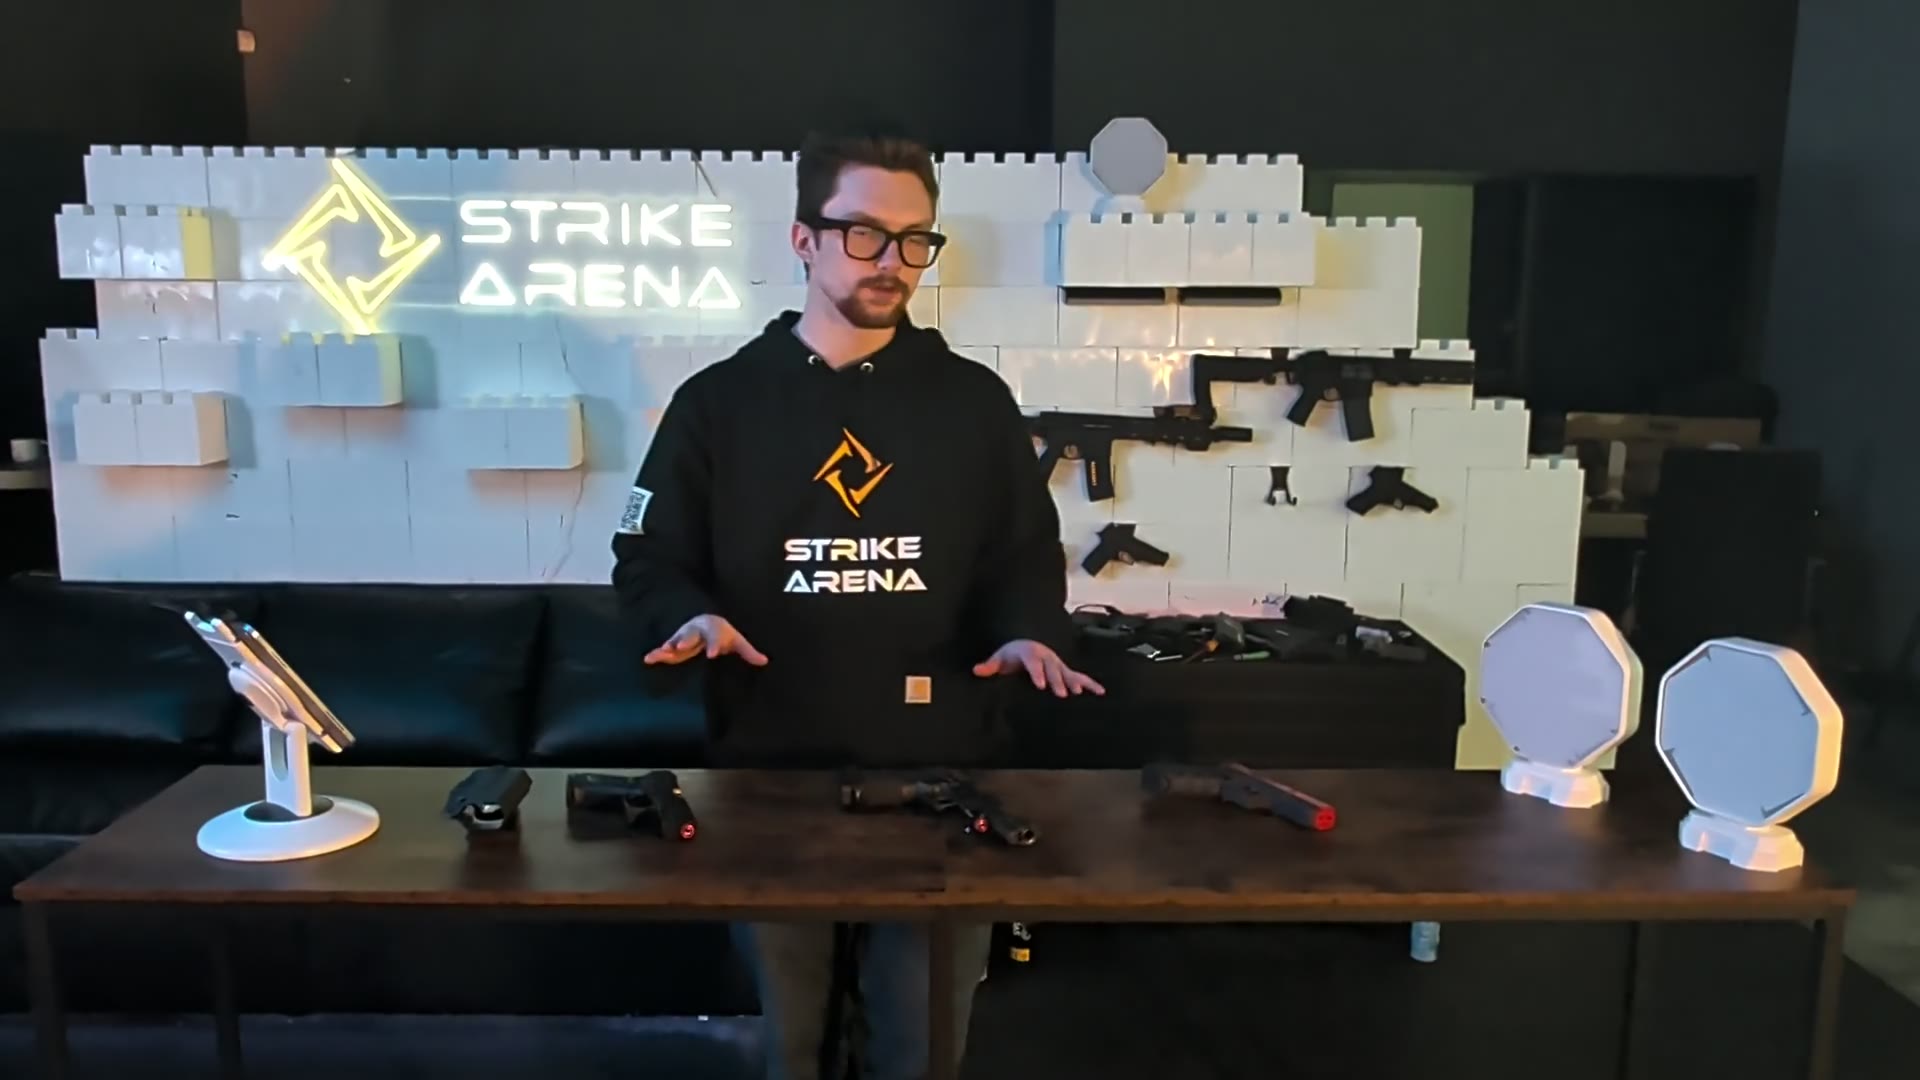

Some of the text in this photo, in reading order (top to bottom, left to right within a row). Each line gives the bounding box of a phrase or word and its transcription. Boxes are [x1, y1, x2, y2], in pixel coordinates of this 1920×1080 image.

[459, 199, 733, 247] STRIKE
[459, 262, 742, 309] ARENA
[784, 536, 922, 561] STRIKE
[783, 568, 928, 593] ARENA
